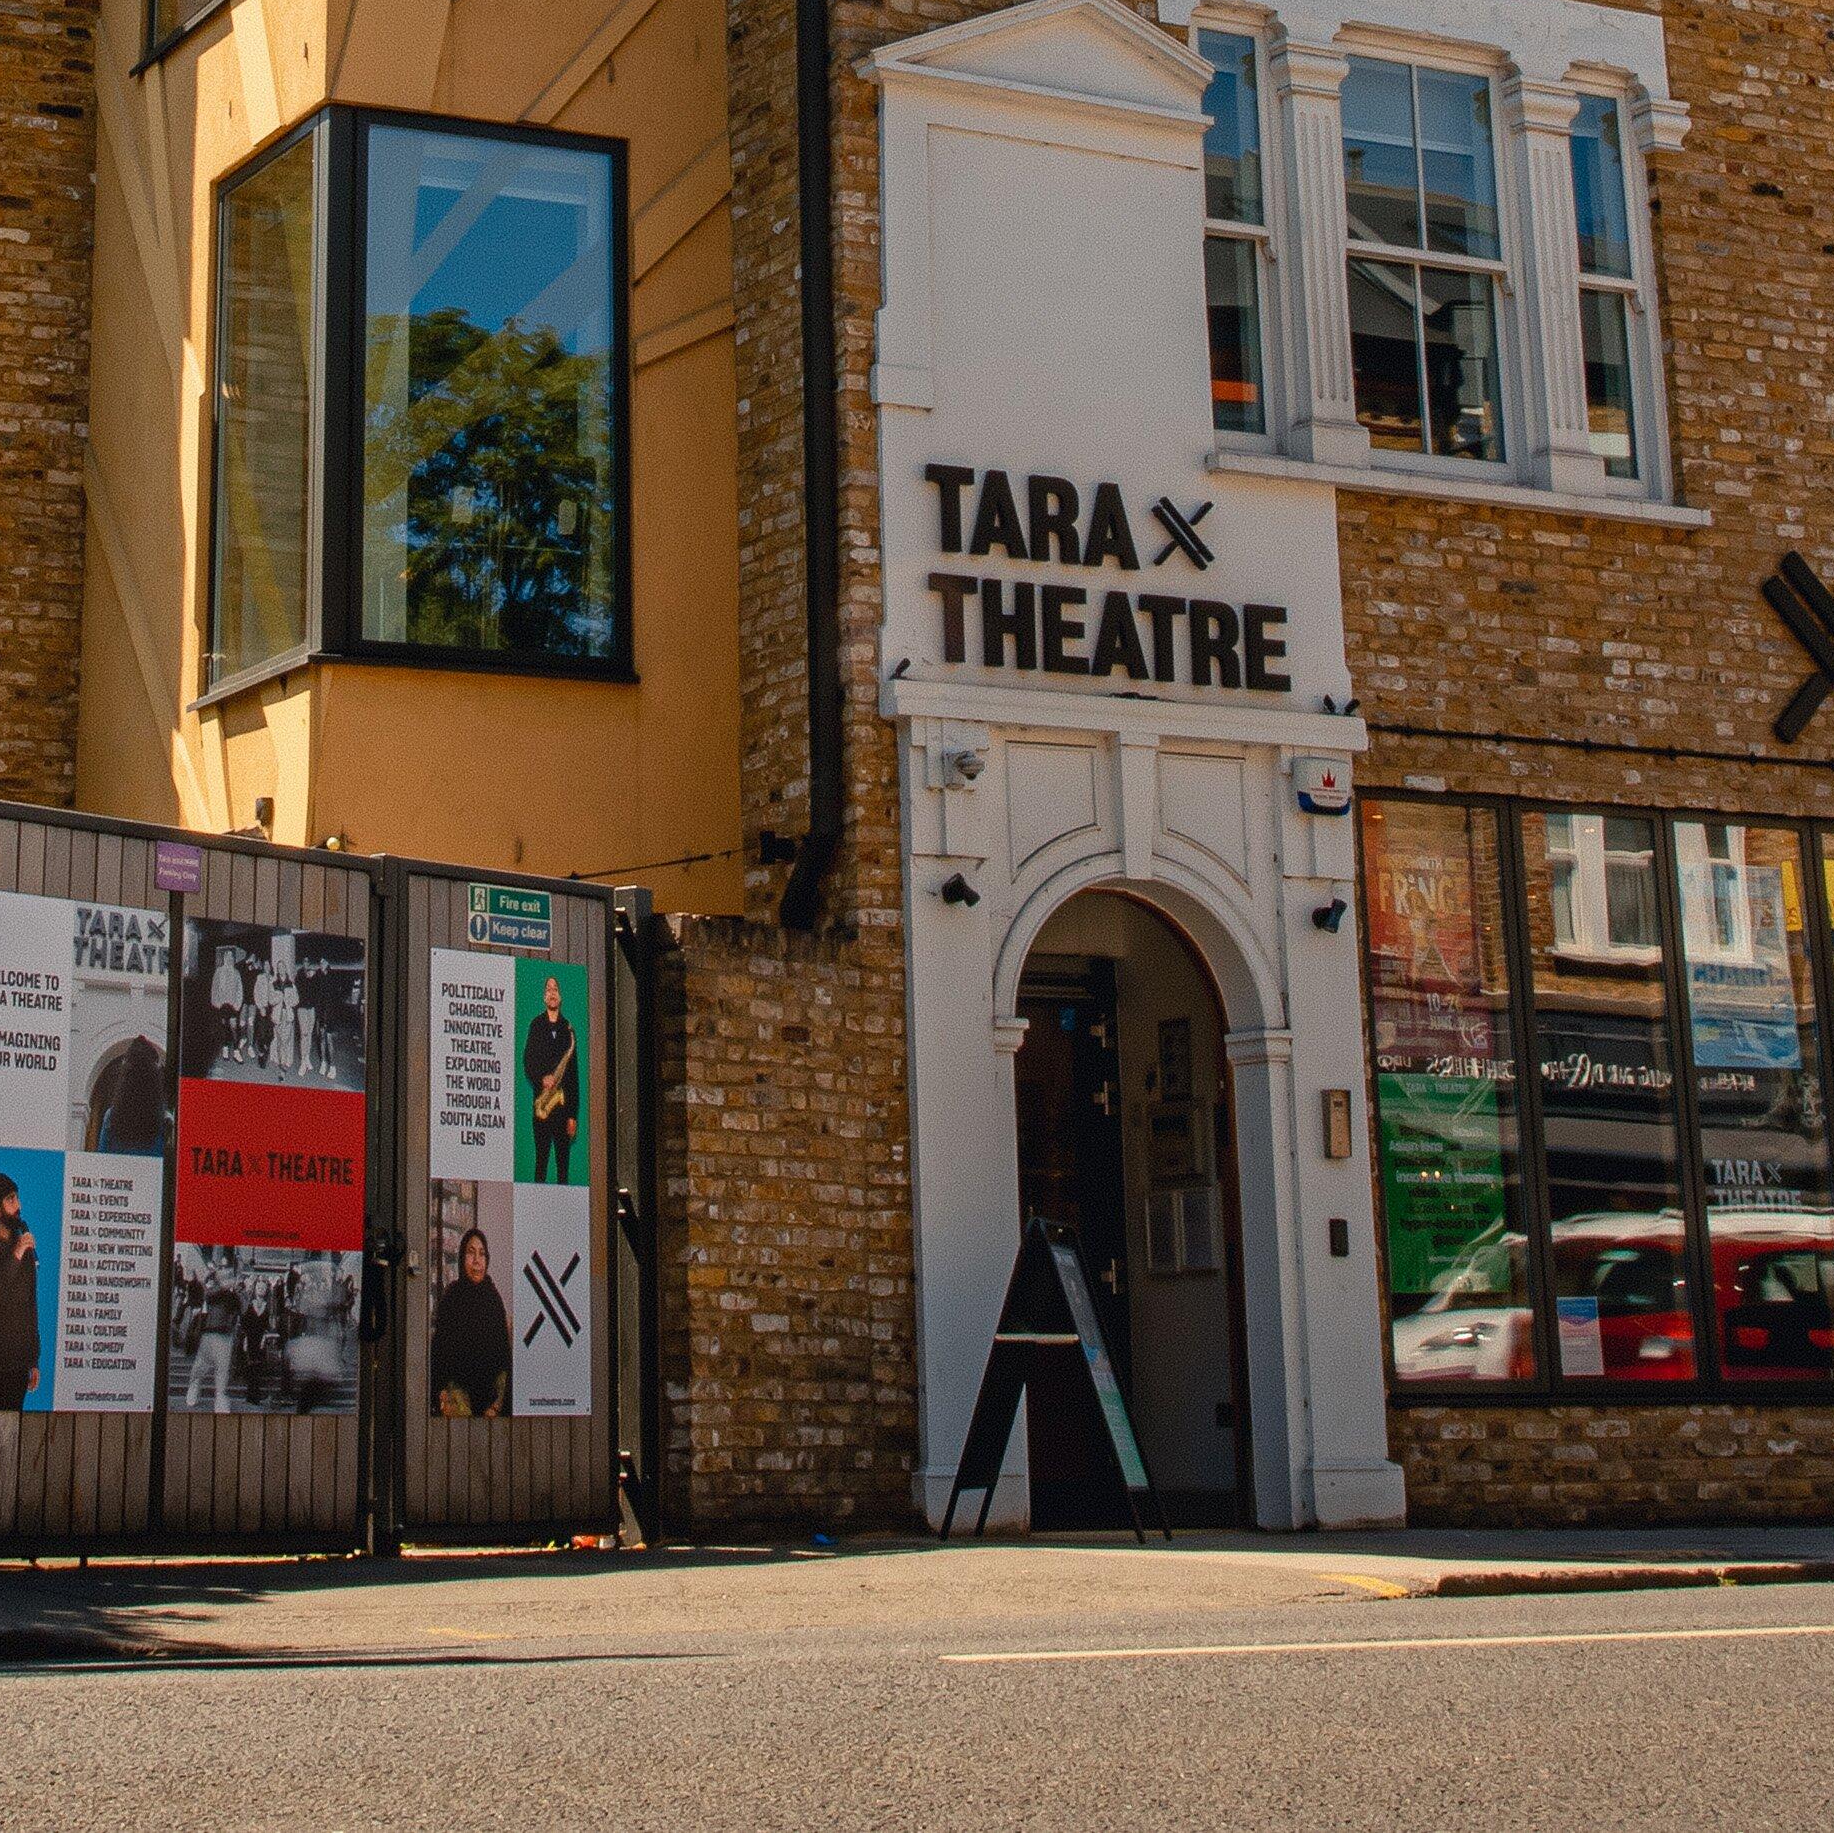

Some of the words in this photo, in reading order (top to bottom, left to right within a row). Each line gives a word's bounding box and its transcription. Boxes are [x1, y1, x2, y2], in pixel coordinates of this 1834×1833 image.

[924, 463, 1141, 571] TARA
[927, 572, 1292, 693] THEATRE
[499, 895, 519, 910] Fire
[521, 900, 541, 913] exit
[77, 907, 142, 942] TARA
[492, 921, 519, 939] Keep
[521, 925, 548, 939] clear
[44, 974, 59, 991] TO
[11, 991, 63, 1012] THEATRE
[442, 983, 505, 1002] POLITICALLY
[448, 1002, 498, 1021] CHARGED,
[443, 1019, 503, 1038] INNOVATIVE
[451, 1038, 496, 1057] THEATRE,
[14, 1052, 57, 1071] WORLD
[445, 1056, 501, 1074] EXPLORING
[446, 1074, 464, 1090] THE
[467, 1076, 501, 1092] WORLD
[446, 1092, 492, 1110] THROUGH
[494, 1096, 500, 1110] A
[440, 1111, 473, 1127] SOUTH
[474, 1115, 505, 1129] ASIAN
[460, 1130, 486, 1146] LENS
[191, 1147, 243, 1177] TARA
[267, 1151, 354, 1186] THEATRE
[1711, 1159, 1764, 1186] TARA
[72, 1176, 92, 1188] TARA
[100, 1178, 134, 1192] THEATRE
[71, 1192, 91, 1204] TARA
[99, 1194, 128, 1207] EVENTS
[70, 1209, 90, 1220] TARA
[98, 1210, 152, 1224] EXPERIENCES
[70, 1225, 89, 1237] TARA
[97, 1227, 145, 1240] COMMUNITY
[69, 1242, 89, 1253] TARA
[117, 1245, 153, 1257] WRITING
[69, 1258, 88, 1269] TARA
[96, 1259, 136, 1272] ACTIVISM
[68, 1274, 87, 1286] TARA
[67, 1291, 86, 1302] TARA
[67, 1308, 86, 1318] TARA
[65, 1324, 85, 1335] TARA
[93, 1325, 127, 1337] CULTURE
[65, 1340, 84, 1352] TARA
[64, 1357, 83, 1368] TARA
